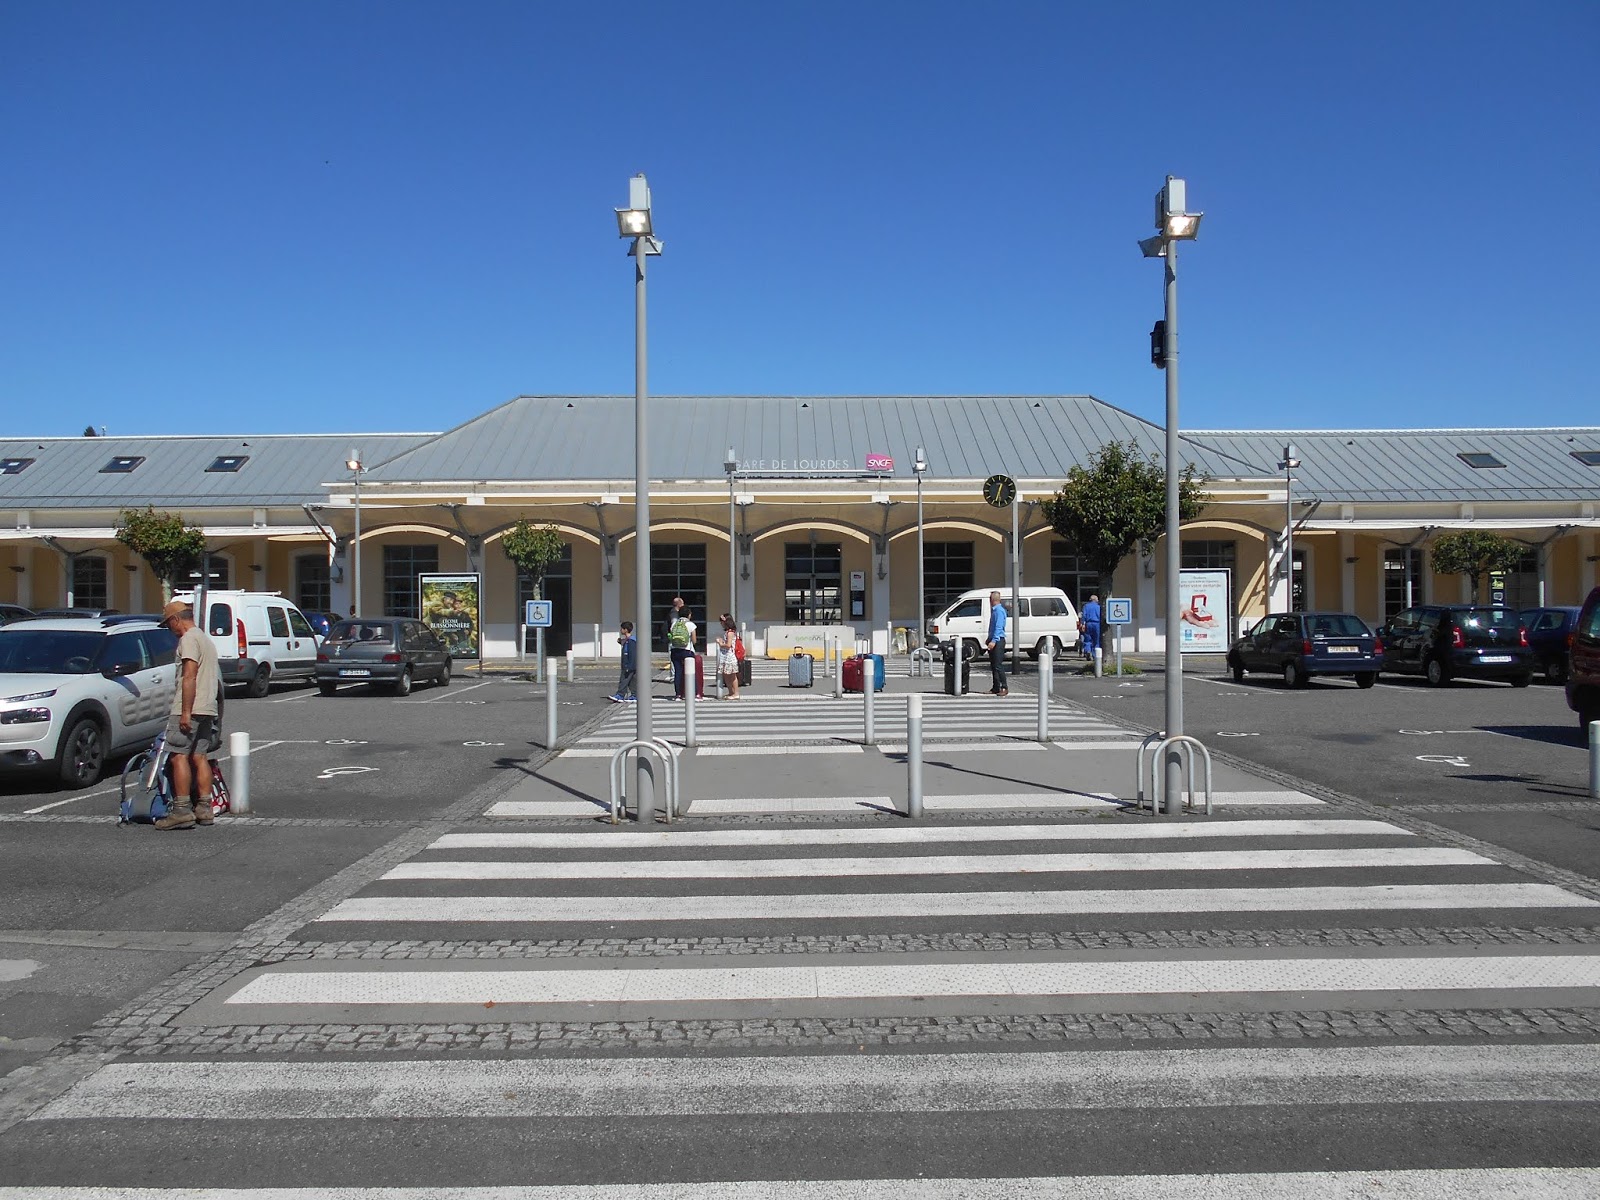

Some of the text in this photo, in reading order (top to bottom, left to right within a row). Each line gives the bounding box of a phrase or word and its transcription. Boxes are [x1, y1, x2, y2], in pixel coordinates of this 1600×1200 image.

[735, 459, 850, 470] GARE DE LOURDES
[867, 458, 893, 467] SNCF
